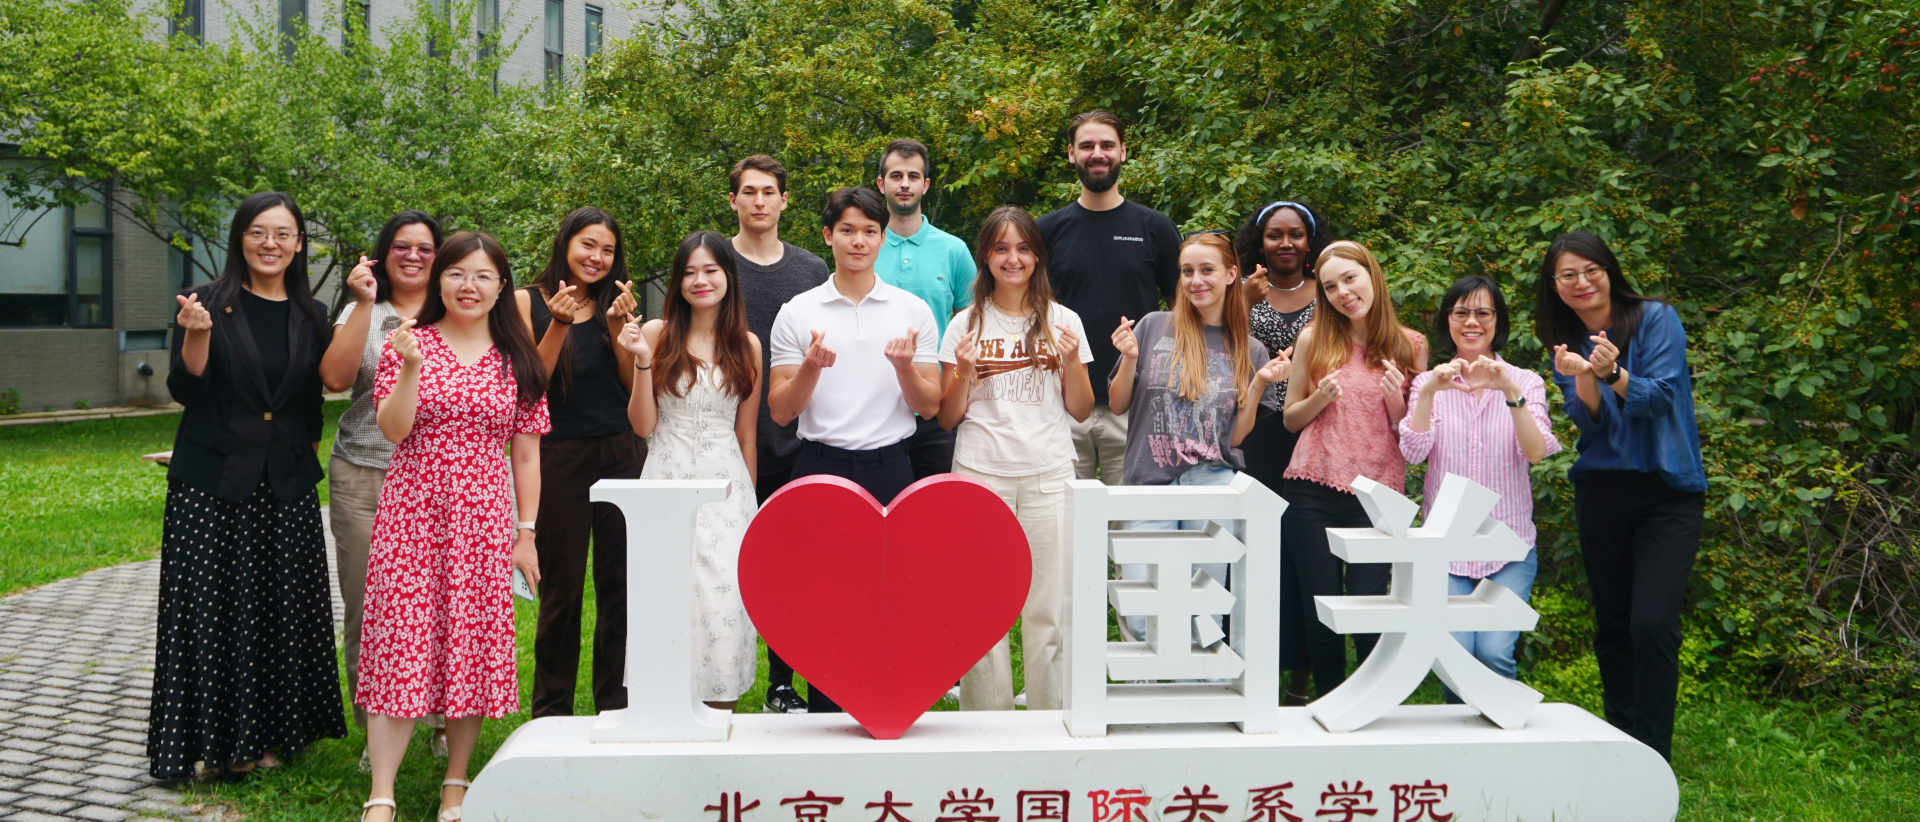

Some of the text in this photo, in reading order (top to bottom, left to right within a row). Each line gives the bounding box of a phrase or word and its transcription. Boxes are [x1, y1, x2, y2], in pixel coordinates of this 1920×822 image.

[979, 337, 1048, 358] WE AE
[590, 472, 1544, 743] I 国关
[703, 779, 1454, 822] 北京大学国际关系学院
